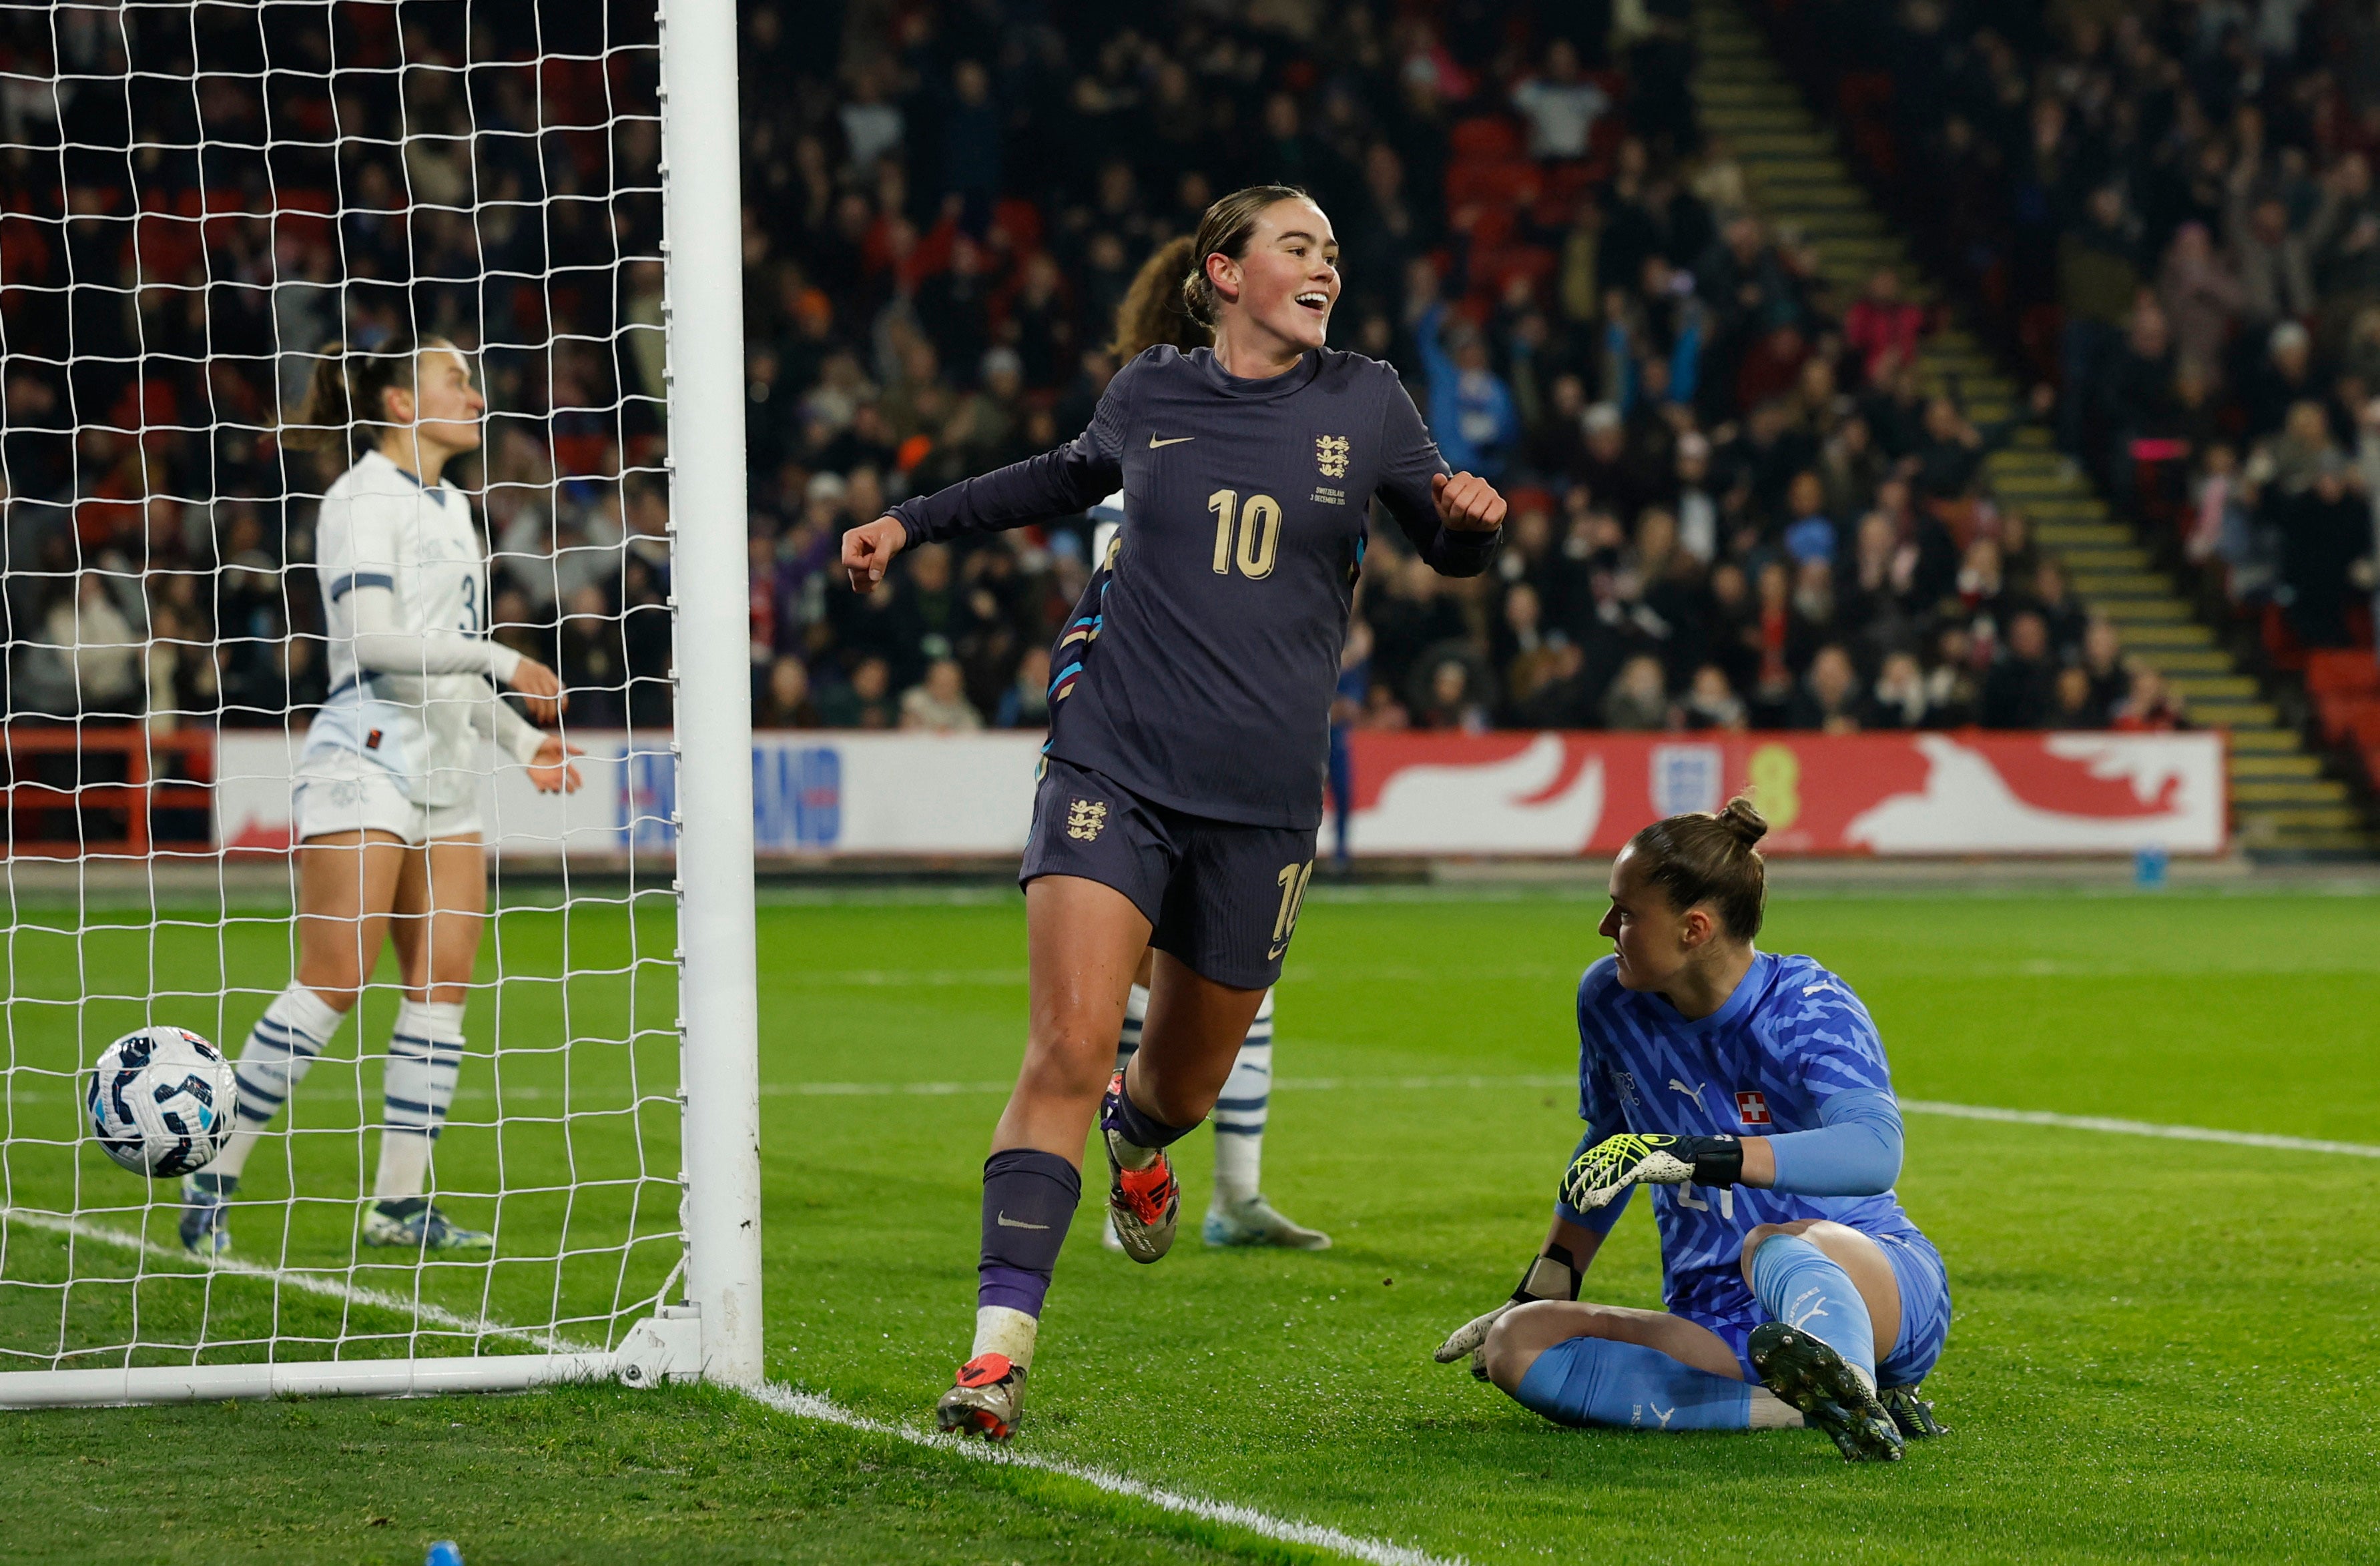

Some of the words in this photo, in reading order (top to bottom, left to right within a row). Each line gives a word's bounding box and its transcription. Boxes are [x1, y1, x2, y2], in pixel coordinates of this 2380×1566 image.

[1314, 494, 1337, 504] DECEMBER
[1315, 486, 1345, 498] SWITZERLAND
[1208, 489, 1282, 580] 10
[459, 575, 478, 638] 3
